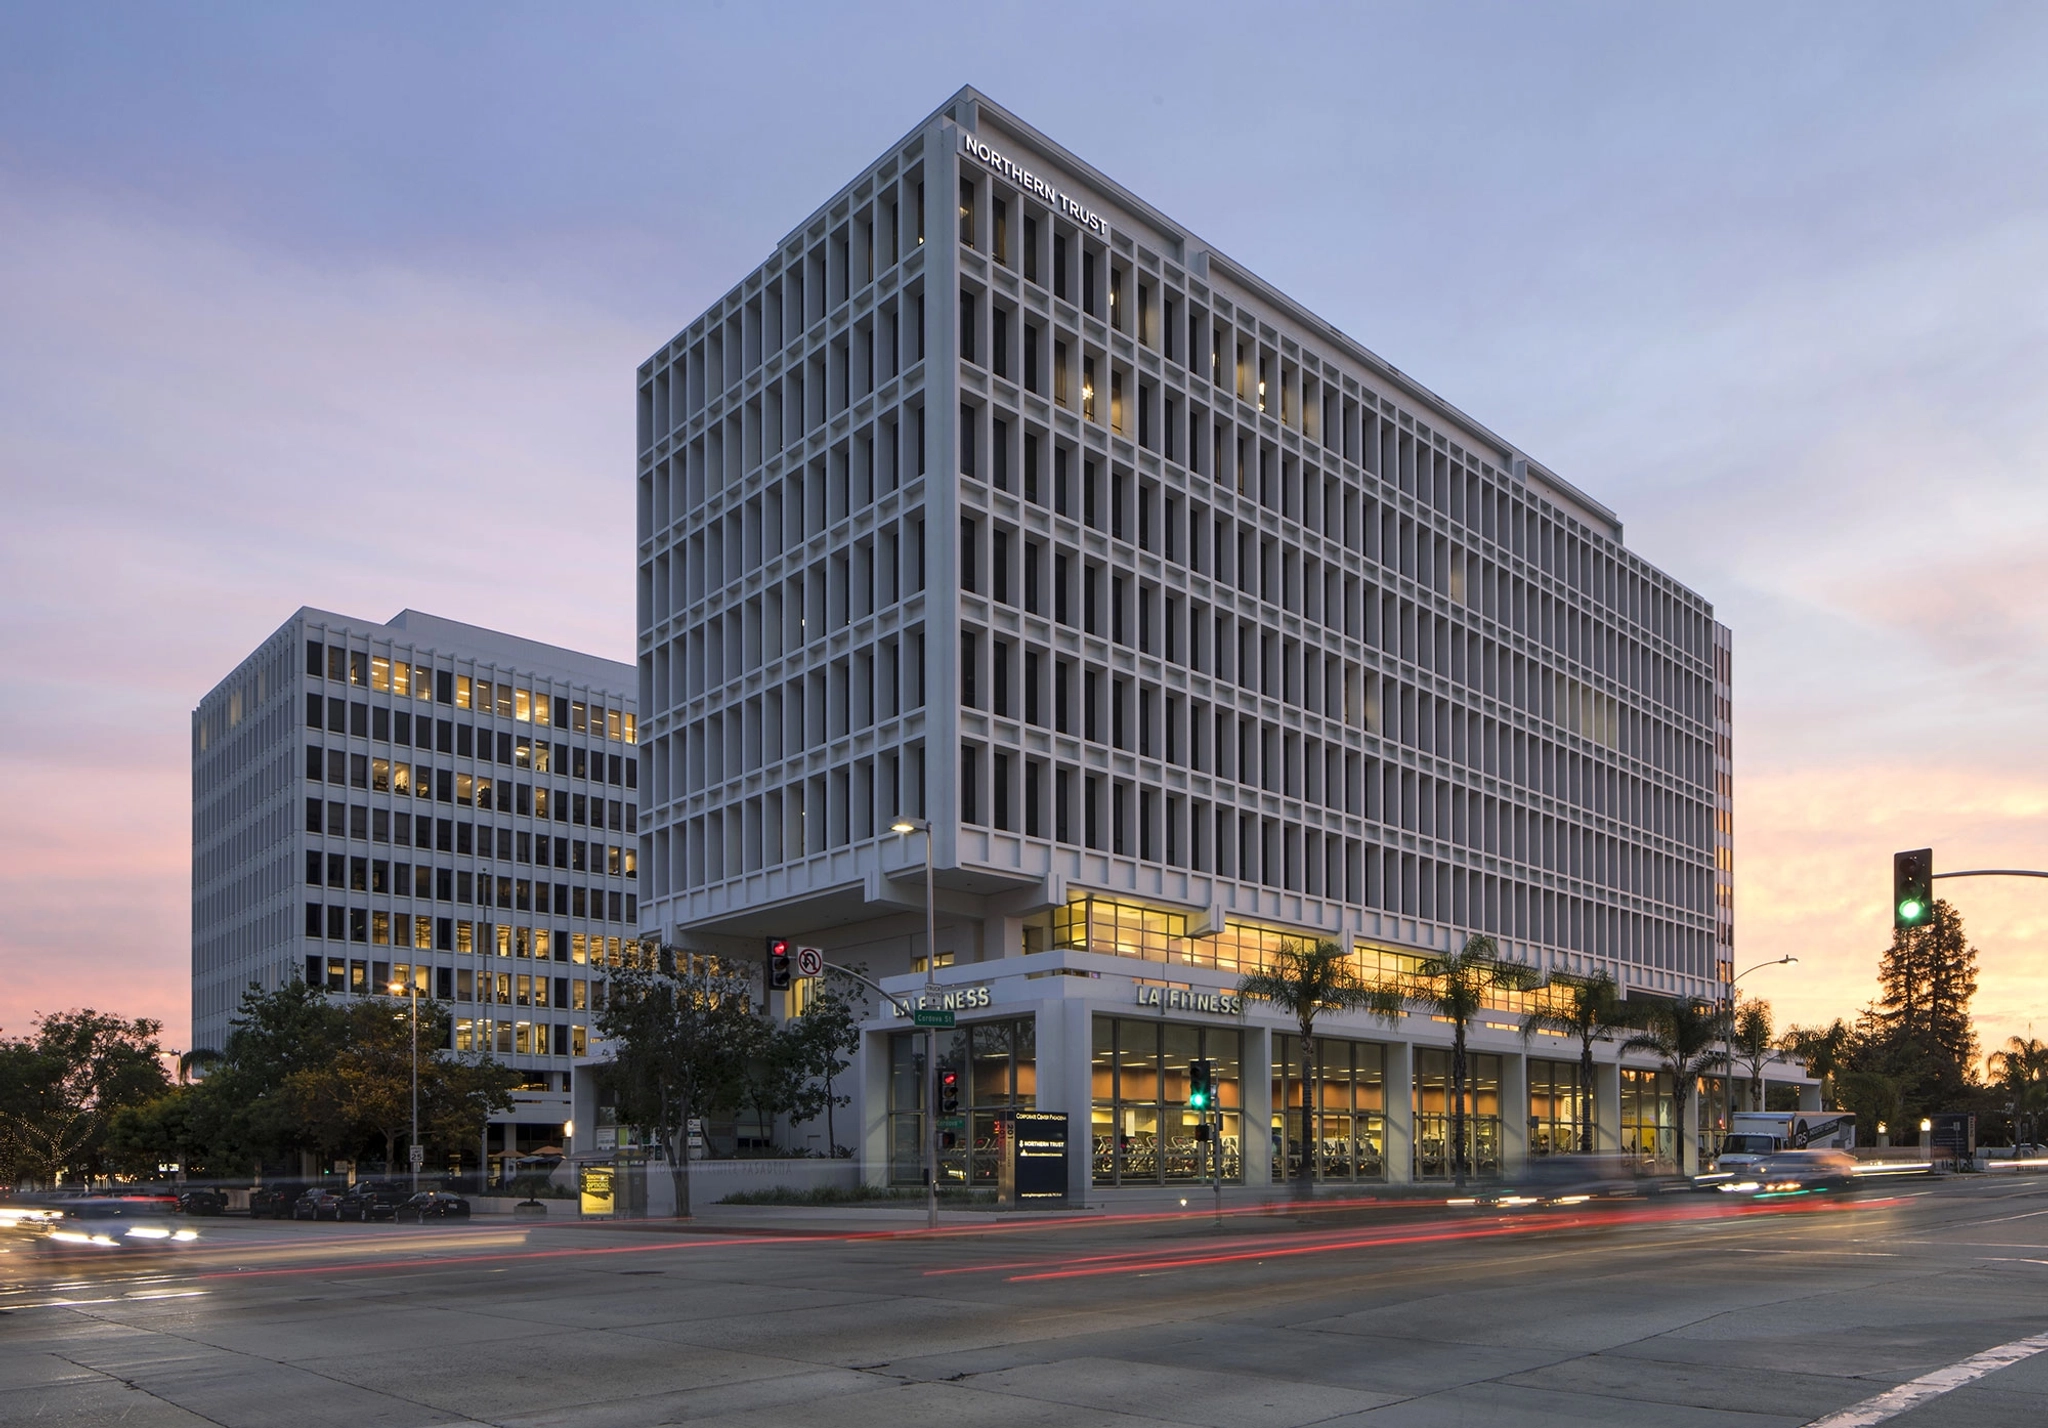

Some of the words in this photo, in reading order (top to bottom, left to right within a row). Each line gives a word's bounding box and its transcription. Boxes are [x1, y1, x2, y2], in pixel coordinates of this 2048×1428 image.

[965, 134, 1055, 204] NORTHERN
[1059, 193, 1107, 234] TRUST
[919, 987, 990, 1011] FNESS
[1137, 985, 1160, 1006] LA
[1168, 988, 1241, 1015] FITNESS
[917, 1014, 943, 1023] Cordova
[944, 1015, 952, 1023] St
[411, 1153, 423, 1161] 25
